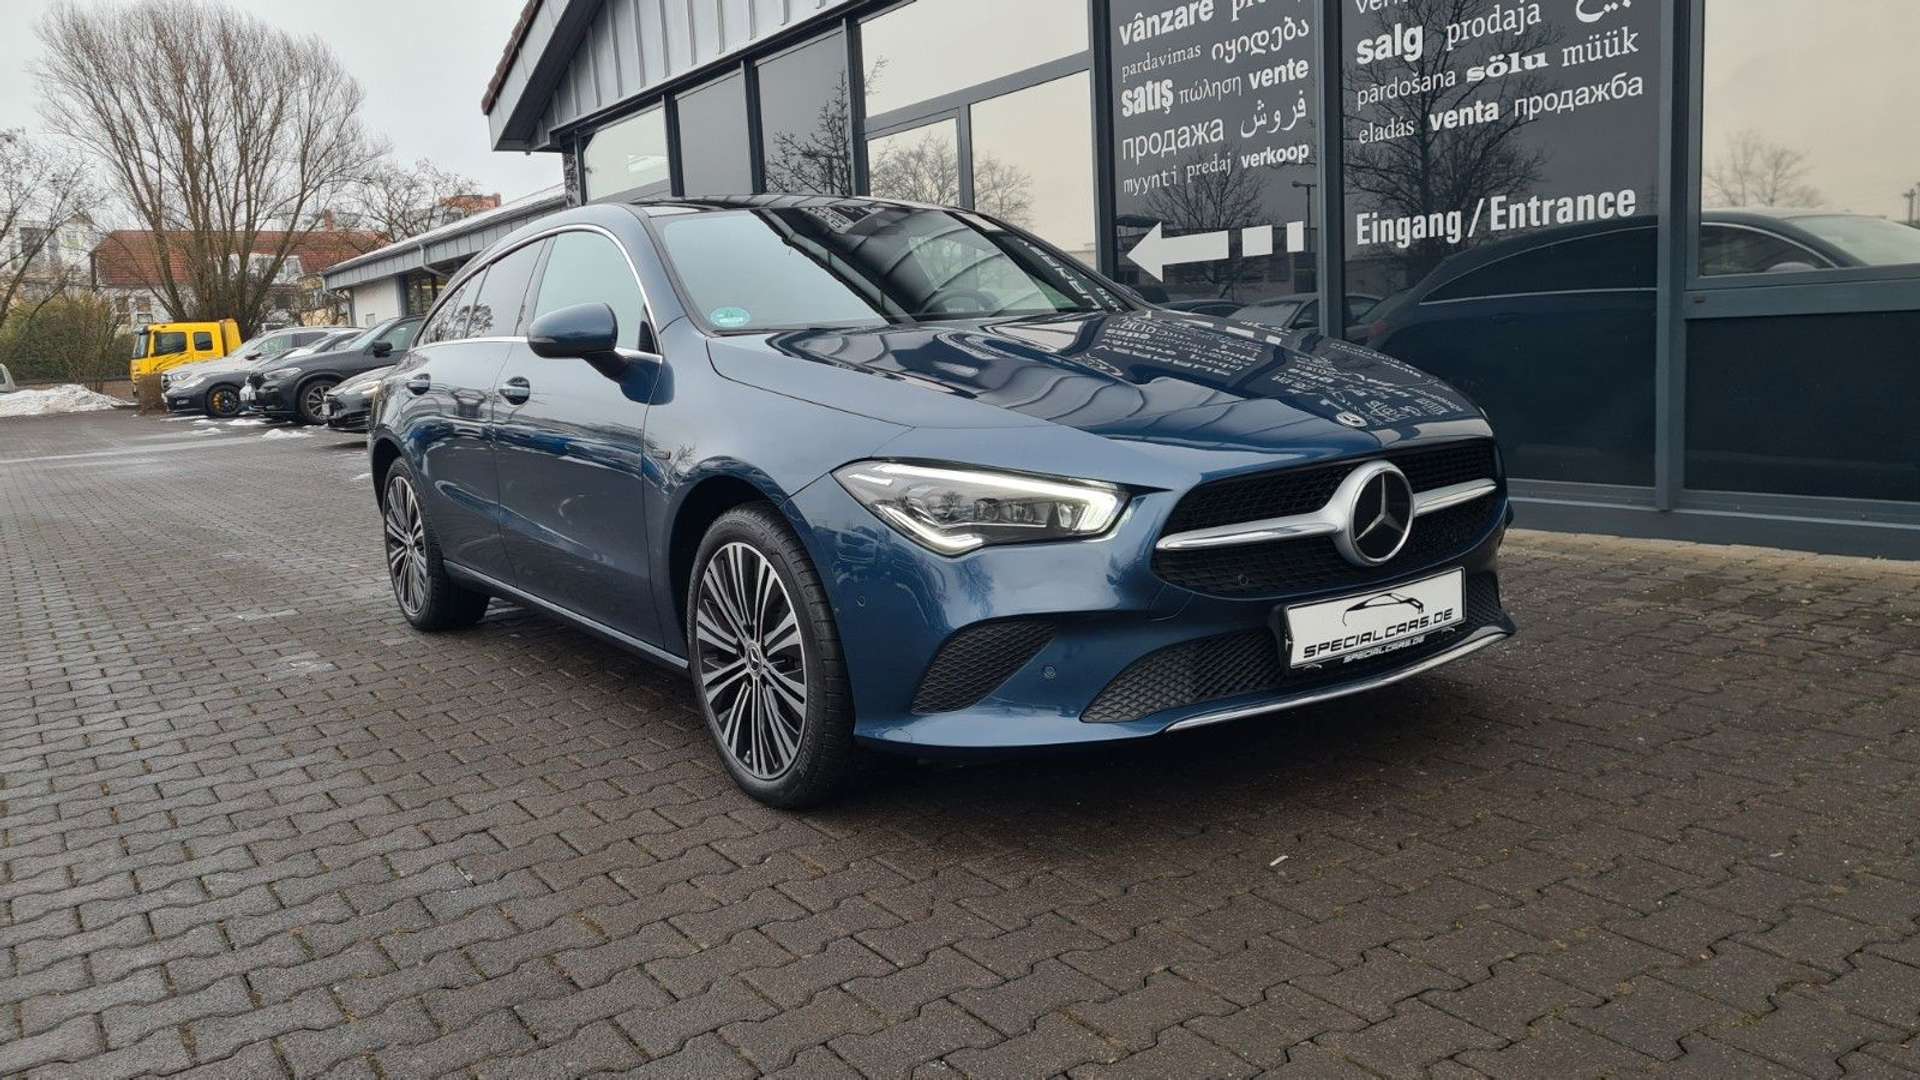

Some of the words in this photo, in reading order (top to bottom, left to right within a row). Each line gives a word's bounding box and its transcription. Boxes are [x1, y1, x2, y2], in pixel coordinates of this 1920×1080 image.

[1119, 0, 1214, 46] vânzare
[1356, 23, 1423, 65] salg
[1446, 0, 1542, 51] prodaja
[1121, 44, 1202, 83] pardavimas
[1248, 58, 1310, 90] vente
[1357, 69, 1456, 111] pārdošana
[1466, 51, 1549, 83] sölu
[1561, 26, 1639, 67] müük
[1121, 79, 1174, 117] satış
[1178, 75, 1242, 105] πώληση
[1514, 72, 1644, 121] продажба
[1240, 90, 1308, 138] فروش
[1358, 115, 1415, 144] eladás
[1428, 100, 1499, 131] venta
[1122, 118, 1225, 165] продажа
[1123, 165, 1178, 196] myynti
[1186, 152, 1232, 184] predaj
[1240, 143, 1310, 169] verkoop
[1356, 209, 1462, 249] Eingang
[1490, 188, 1636, 231] Entrance
[1303, 608, 1454, 659] SPECIALCARS.DE
